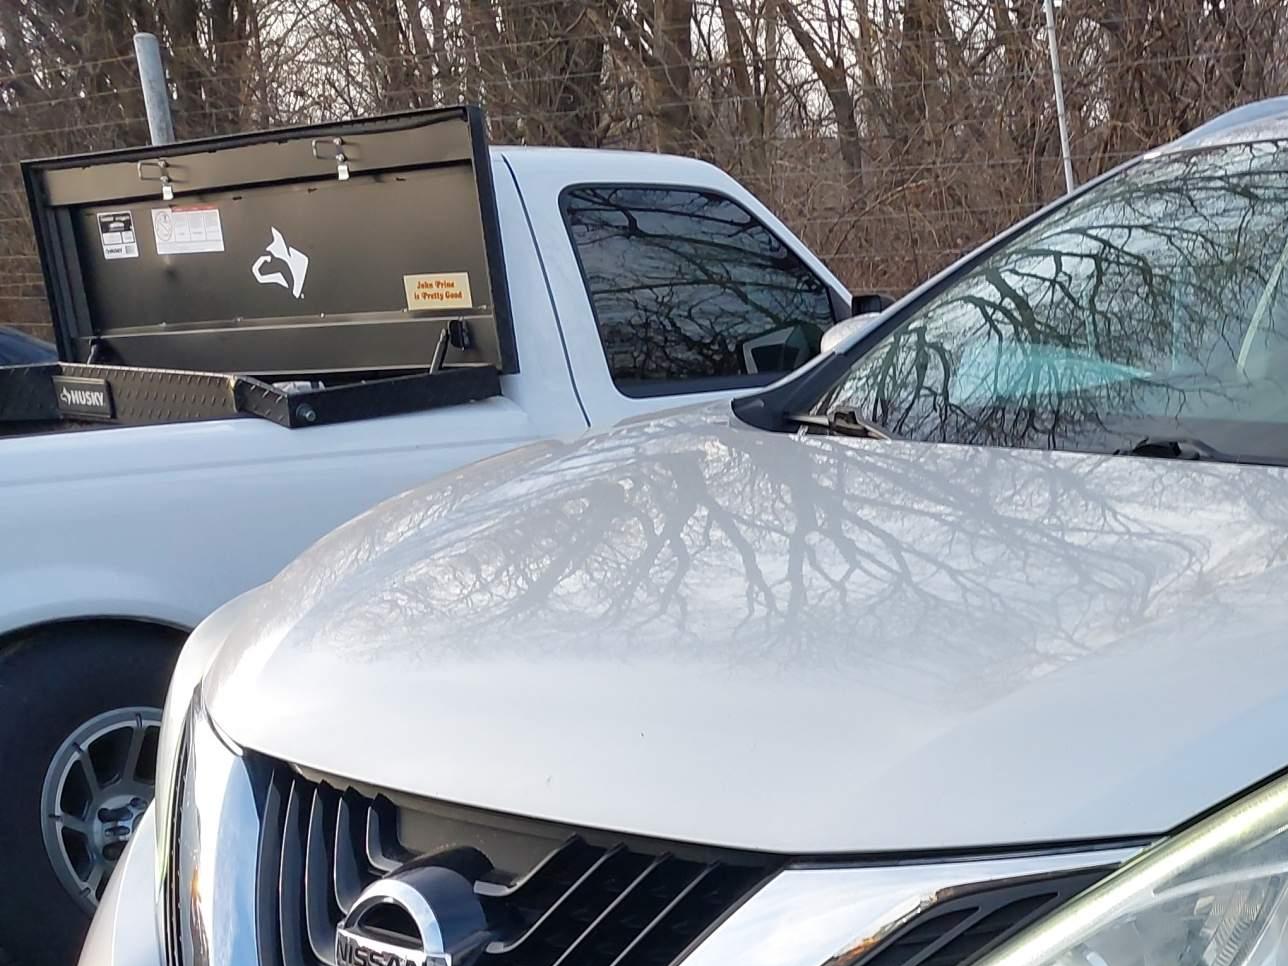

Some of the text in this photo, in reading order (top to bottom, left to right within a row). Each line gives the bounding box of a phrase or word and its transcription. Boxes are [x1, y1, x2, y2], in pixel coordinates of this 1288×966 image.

[417, 279, 454, 289] John Prine
[421, 291, 444, 301] Pretty
[445, 290, 463, 299] Good
[71, 389, 104, 407] HUSKY
